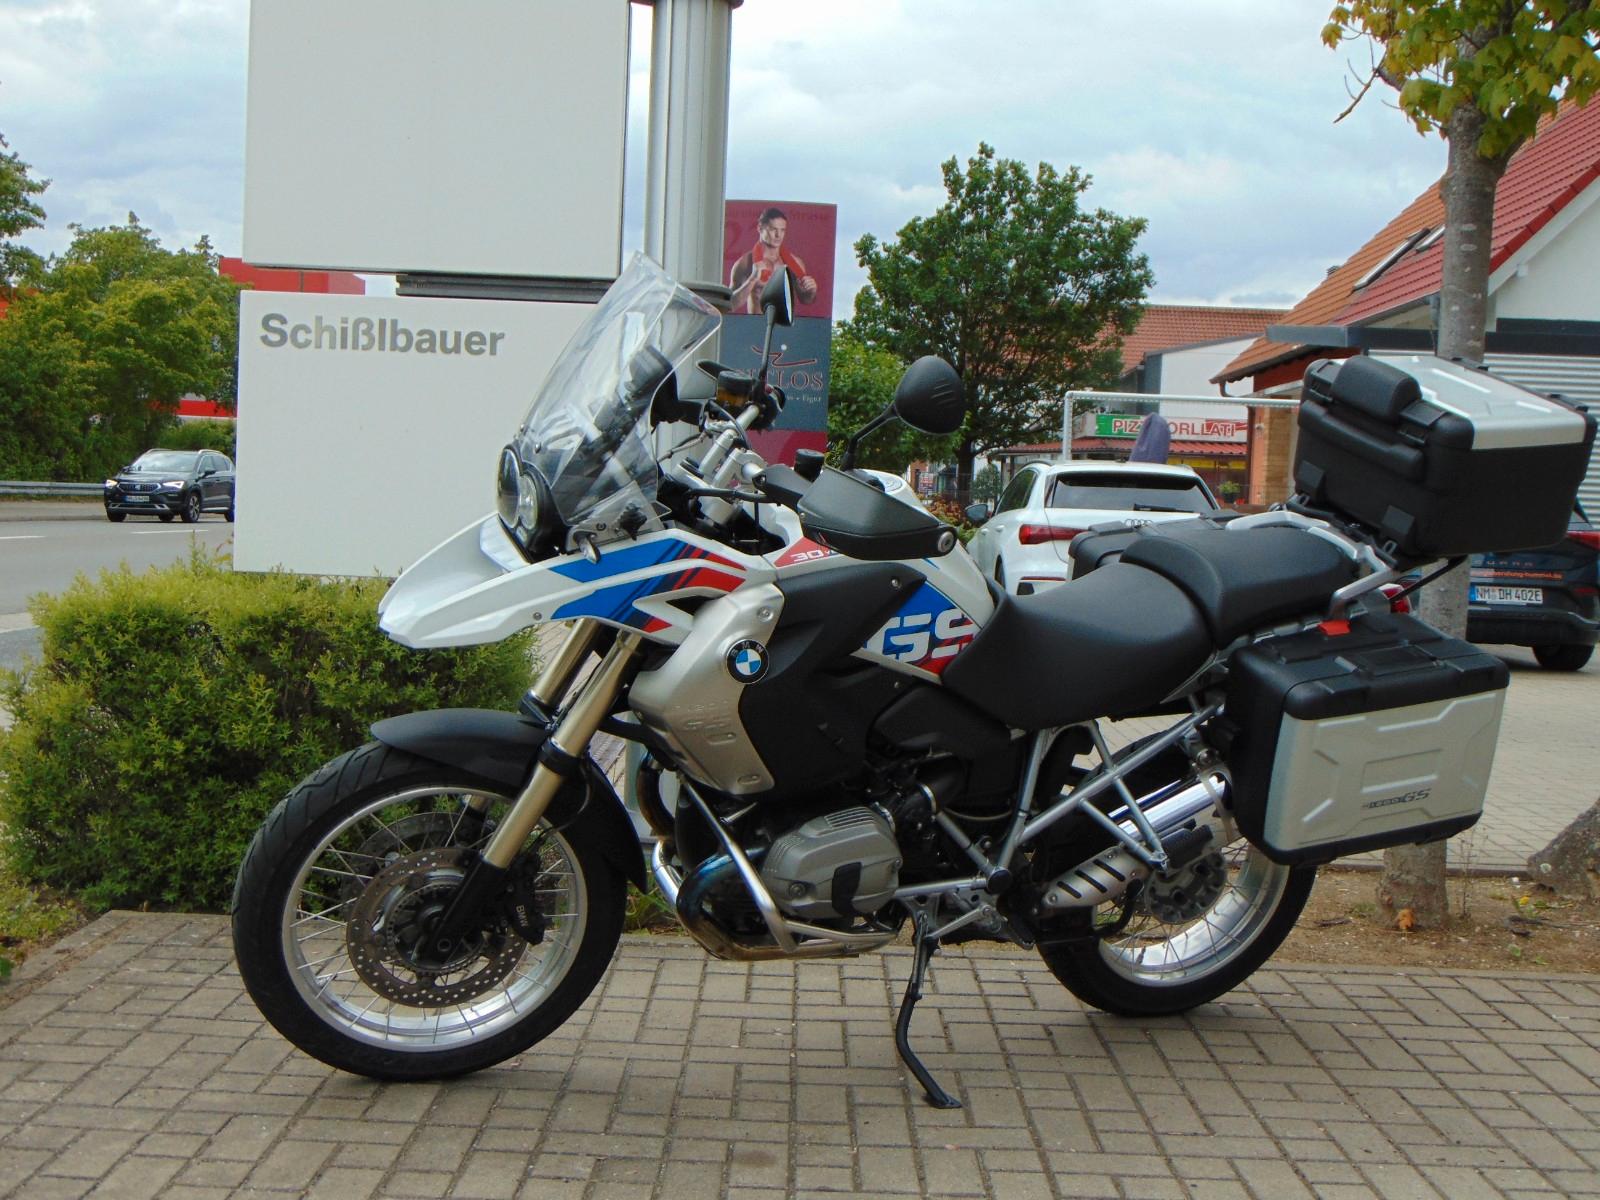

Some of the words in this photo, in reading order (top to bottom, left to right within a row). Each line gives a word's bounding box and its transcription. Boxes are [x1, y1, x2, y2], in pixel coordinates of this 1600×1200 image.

[260, 313, 505, 356] Schißlbauer
[791, 549, 823, 562] 30
[1477, 587, 1491, 601] NM
[1515, 589, 1542, 602] 402E
[866, 608, 981, 662] GS
[731, 641, 765, 657] BMW
